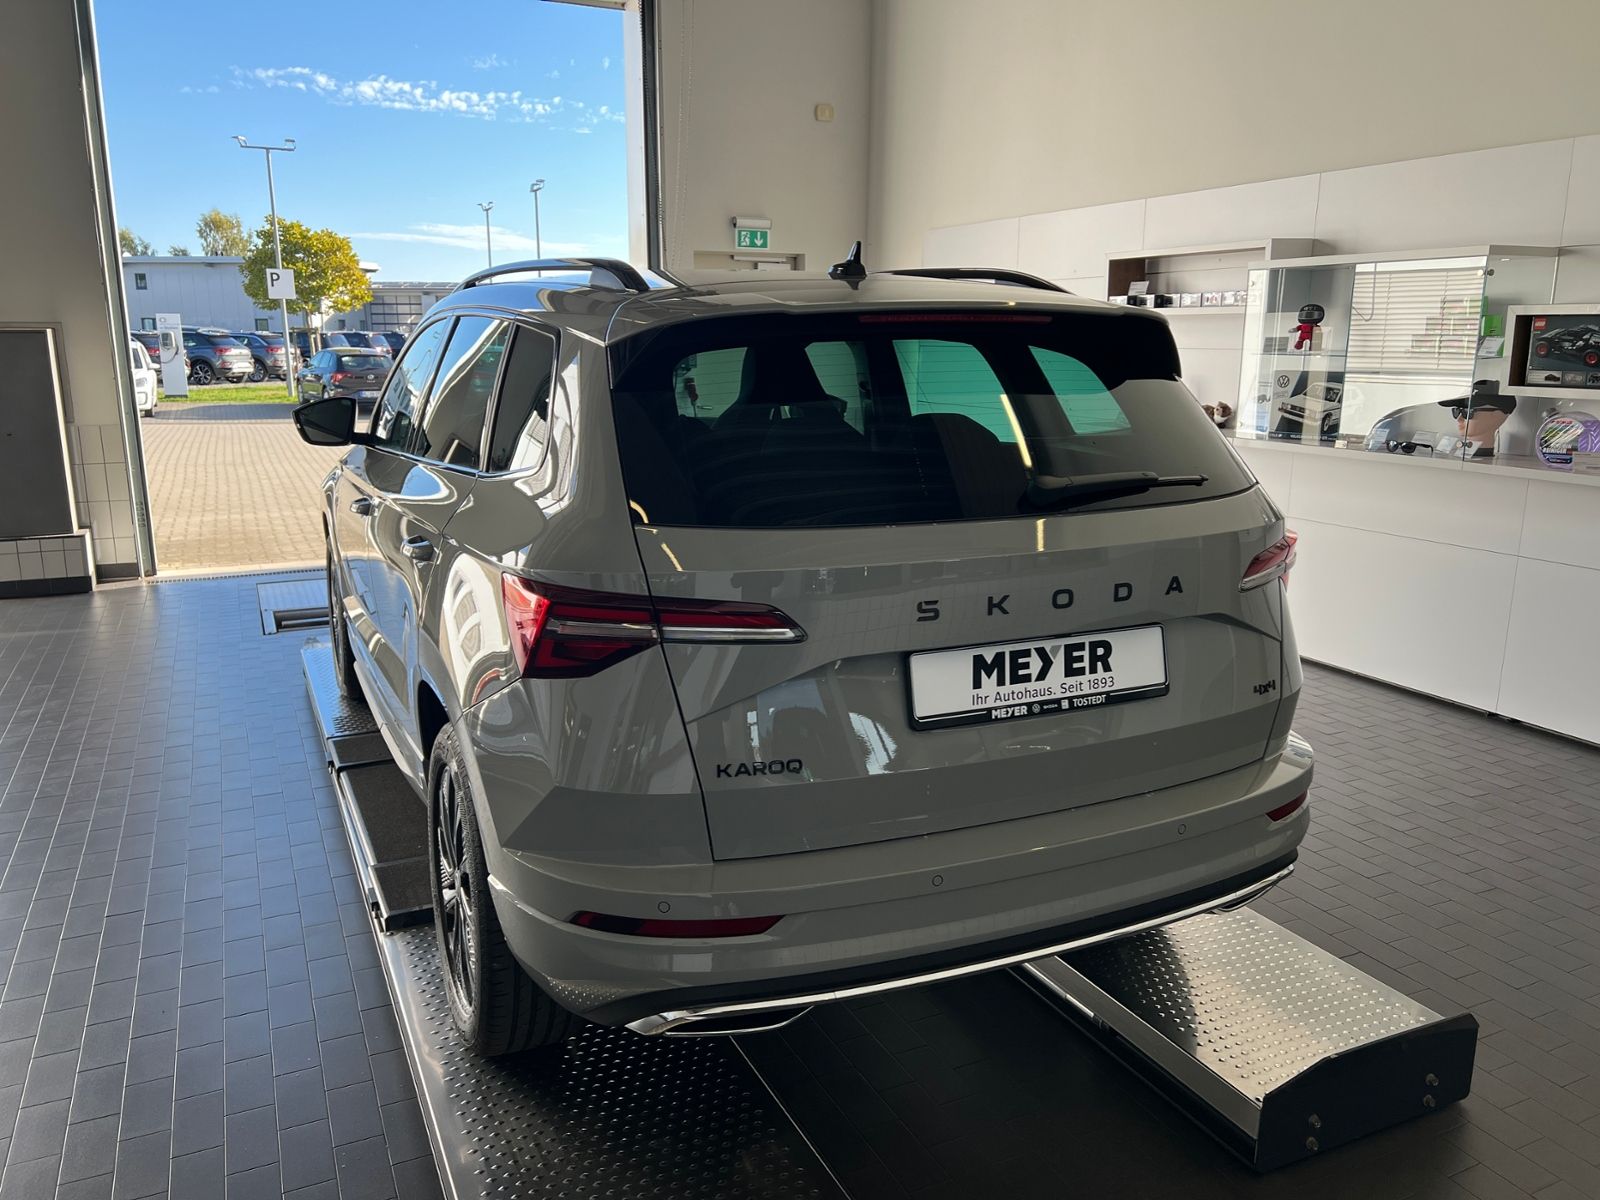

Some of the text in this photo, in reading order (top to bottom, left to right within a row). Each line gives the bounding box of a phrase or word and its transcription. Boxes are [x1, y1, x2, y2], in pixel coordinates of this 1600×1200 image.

[270, 272, 280, 287] P
[972, 639, 1113, 690] MEYER
[972, 676, 1115, 706] Ihr Autohaus. Seit 1893
[1073, 694, 1107, 708] TOSTEDT
[991, 705, 1028, 719] MEYER
[716, 758, 803, 778] KAROQ
